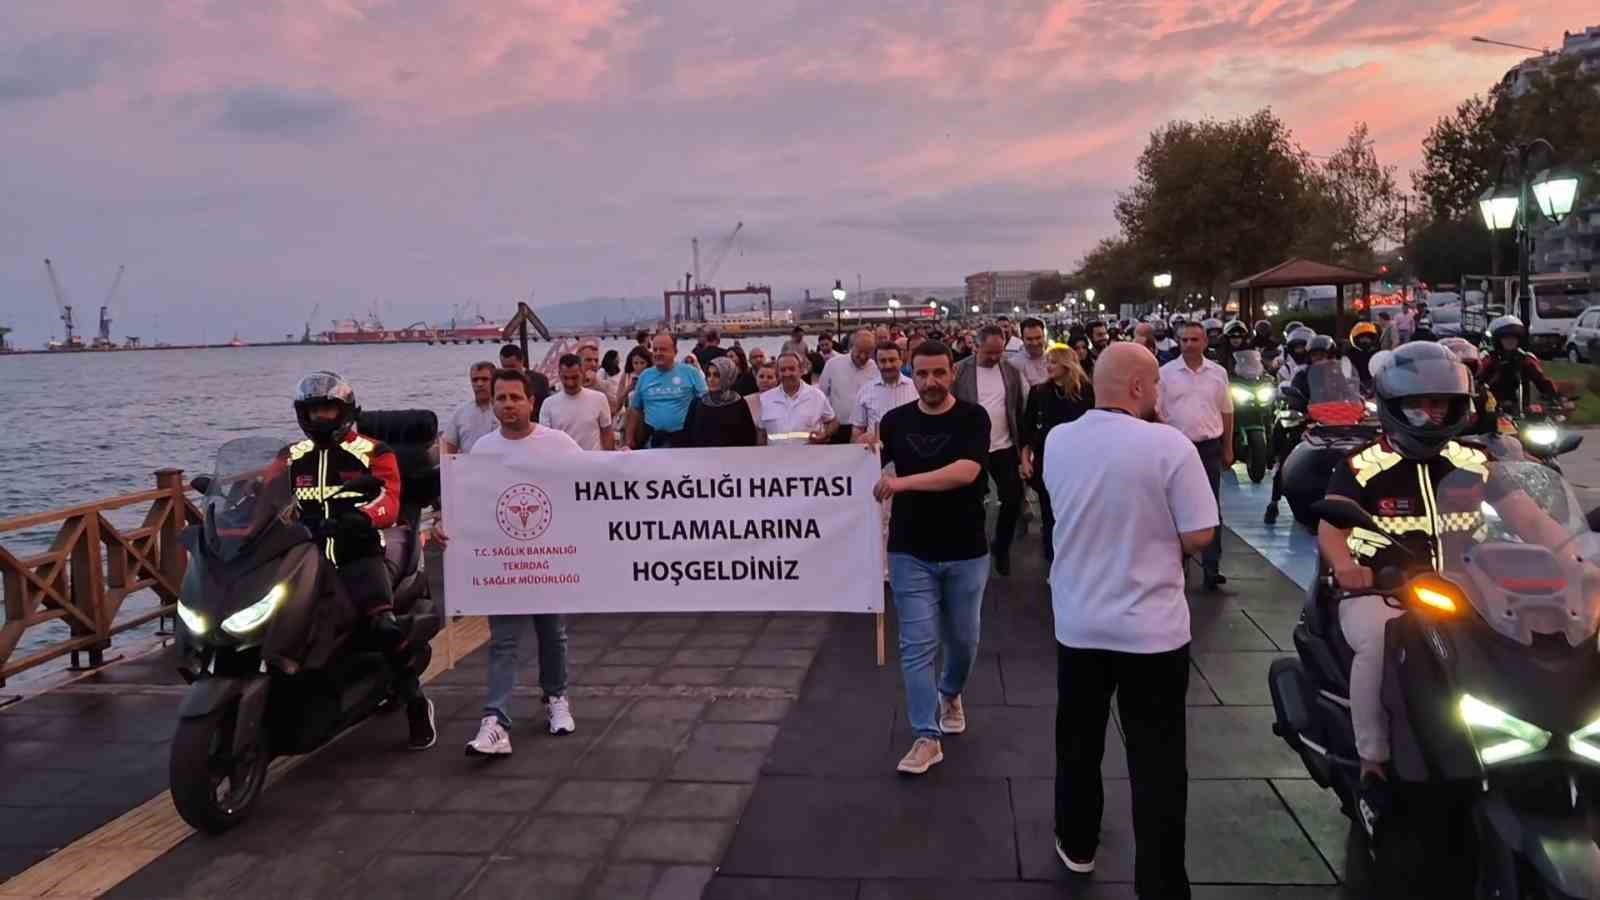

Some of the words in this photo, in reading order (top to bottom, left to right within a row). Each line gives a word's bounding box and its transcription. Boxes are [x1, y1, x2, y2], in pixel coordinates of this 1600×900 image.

[575, 481, 640, 500] HALK
[647, 475, 742, 500] SAĞLIĞI
[749, 476, 853, 499] HAFTASI
[608, 519, 821, 541] KUTLAMALARINA
[473, 549, 490, 557] T.C.
[493, 546, 526, 557] SAĞLIK
[527, 545, 577, 556] BAKANLIĞI
[503, 560, 550, 571] TEKİRDAĞ
[633, 556, 800, 587] HOŞGELDİNİZ
[483, 575, 517, 586] SAĞLIK
[518, 573, 580, 585] MÜDÜRLÜĞÜ
